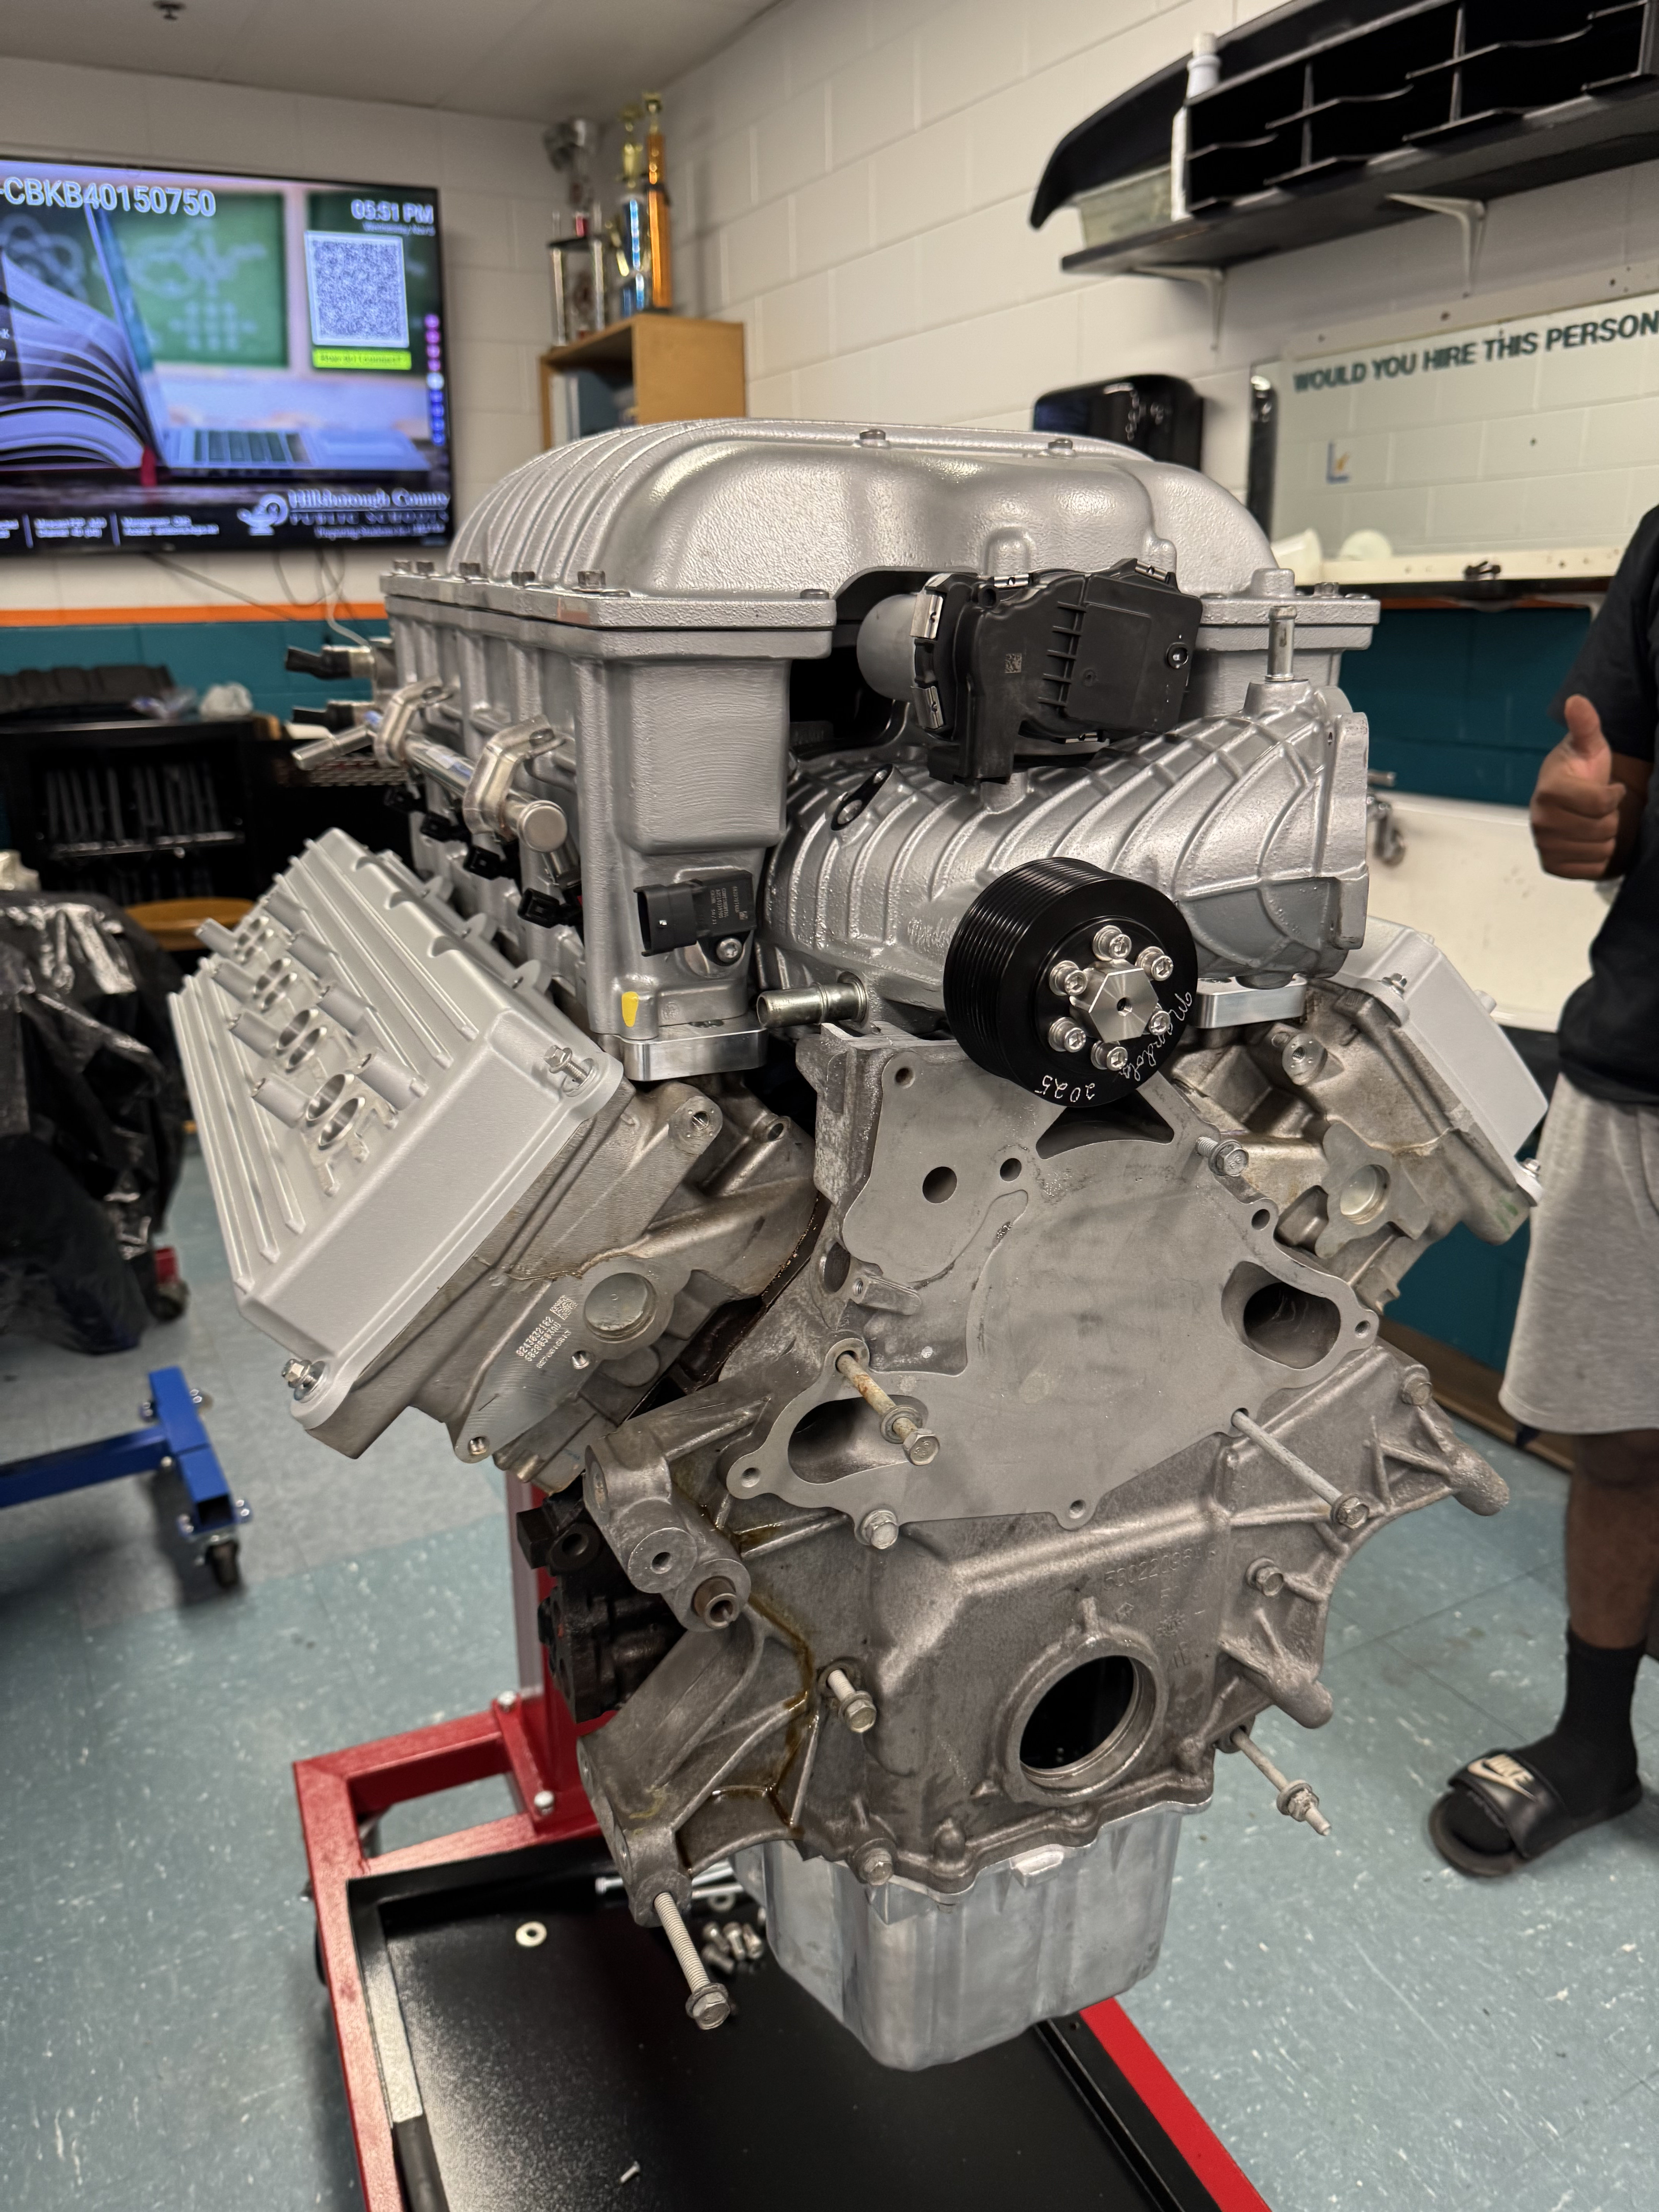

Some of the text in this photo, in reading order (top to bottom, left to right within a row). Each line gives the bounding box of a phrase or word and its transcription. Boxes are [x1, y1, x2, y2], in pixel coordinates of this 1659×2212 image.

[402, 201, 434, 224] PM
[1293, 310, 1659, 392] WOULD YOU HIRE THIS PERSON
[1034, 1075, 1095, 1103] 2025
[1486, 1753, 1535, 1784] NIKE
